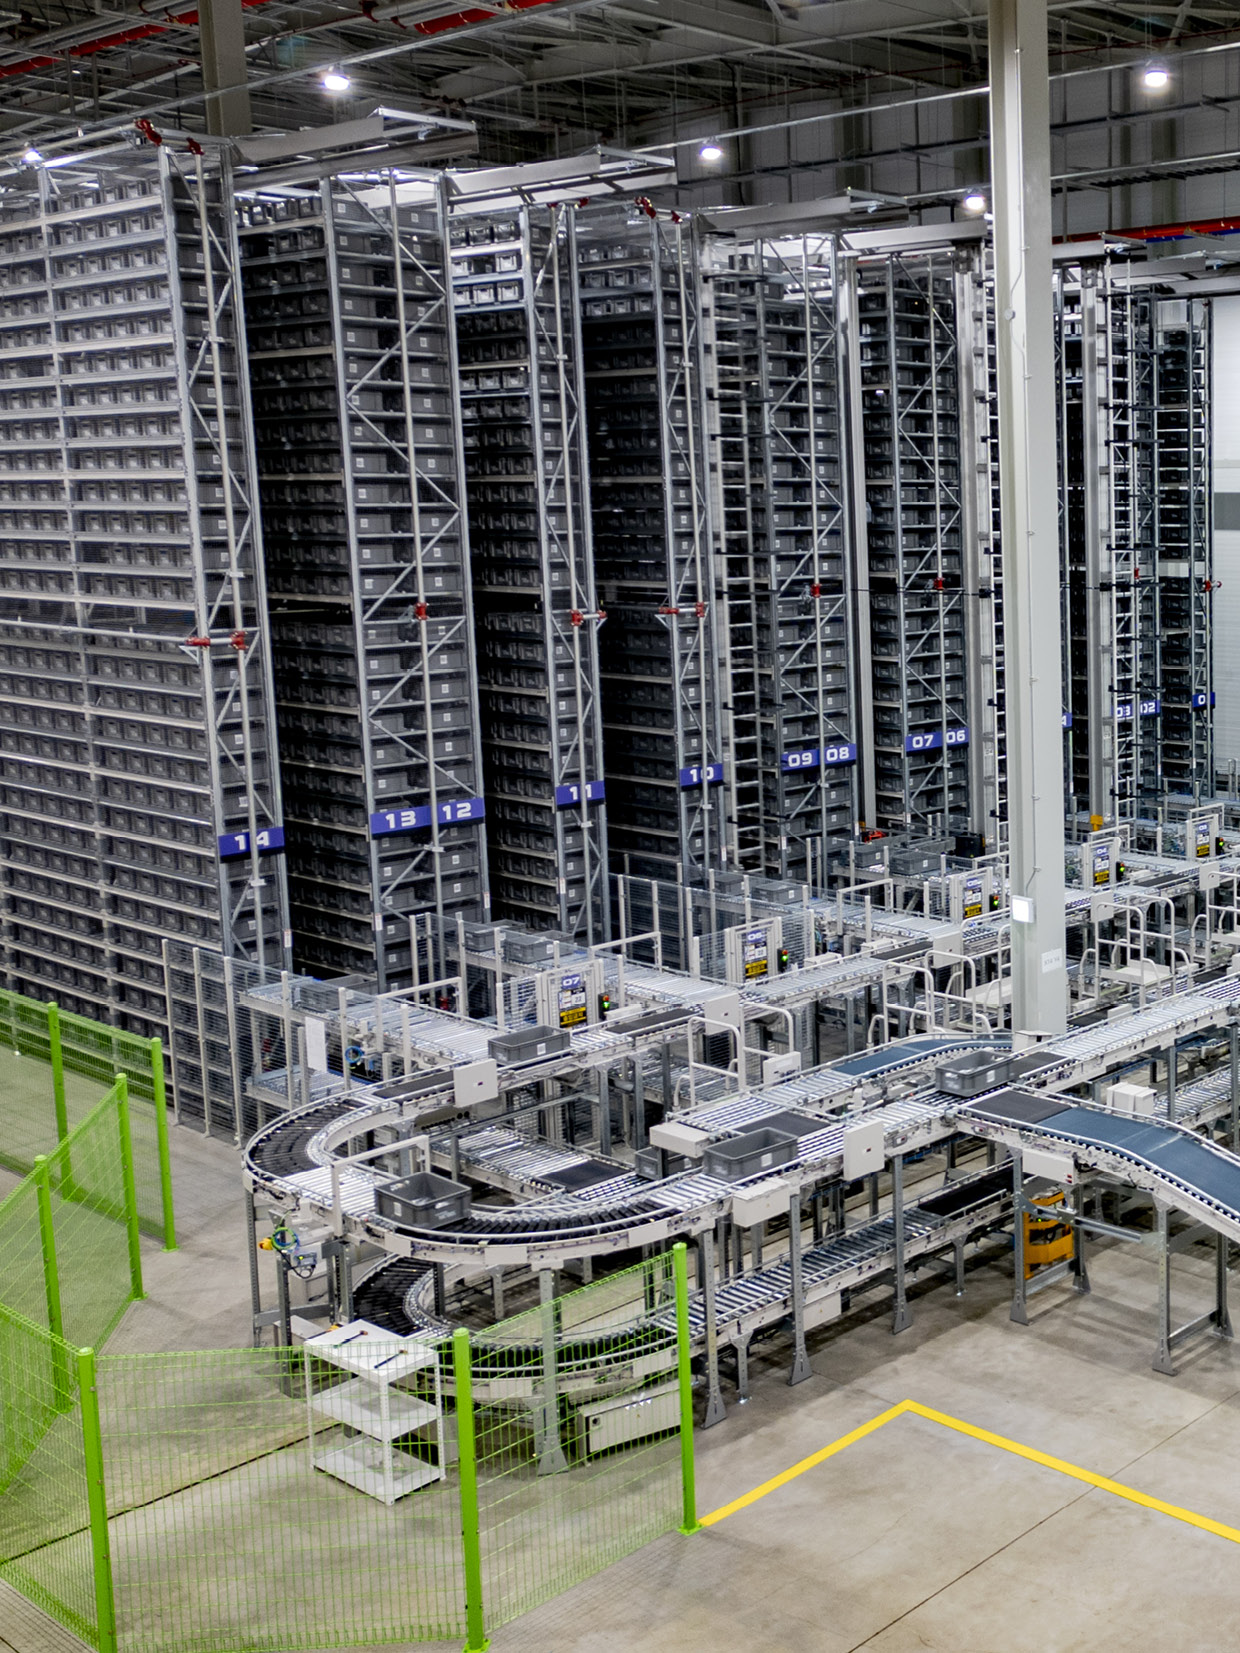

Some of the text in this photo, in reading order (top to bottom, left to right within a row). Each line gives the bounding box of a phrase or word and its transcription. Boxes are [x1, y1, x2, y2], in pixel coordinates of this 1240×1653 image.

[1116, 705, 1131, 717] 03
[1140, 702, 1155, 714] 02
[912, 734, 934, 748] 07
[946, 729, 966, 743] 06
[788, 752, 813, 767] 09
[826, 747, 850, 762] 08
[689, 766, 715, 782] 10
[569, 783, 593, 800] 11
[442, 802, 472, 820] 12
[384, 810, 416, 829] 13
[234, 830, 271, 850] 14
[562, 976, 580, 987] 07
